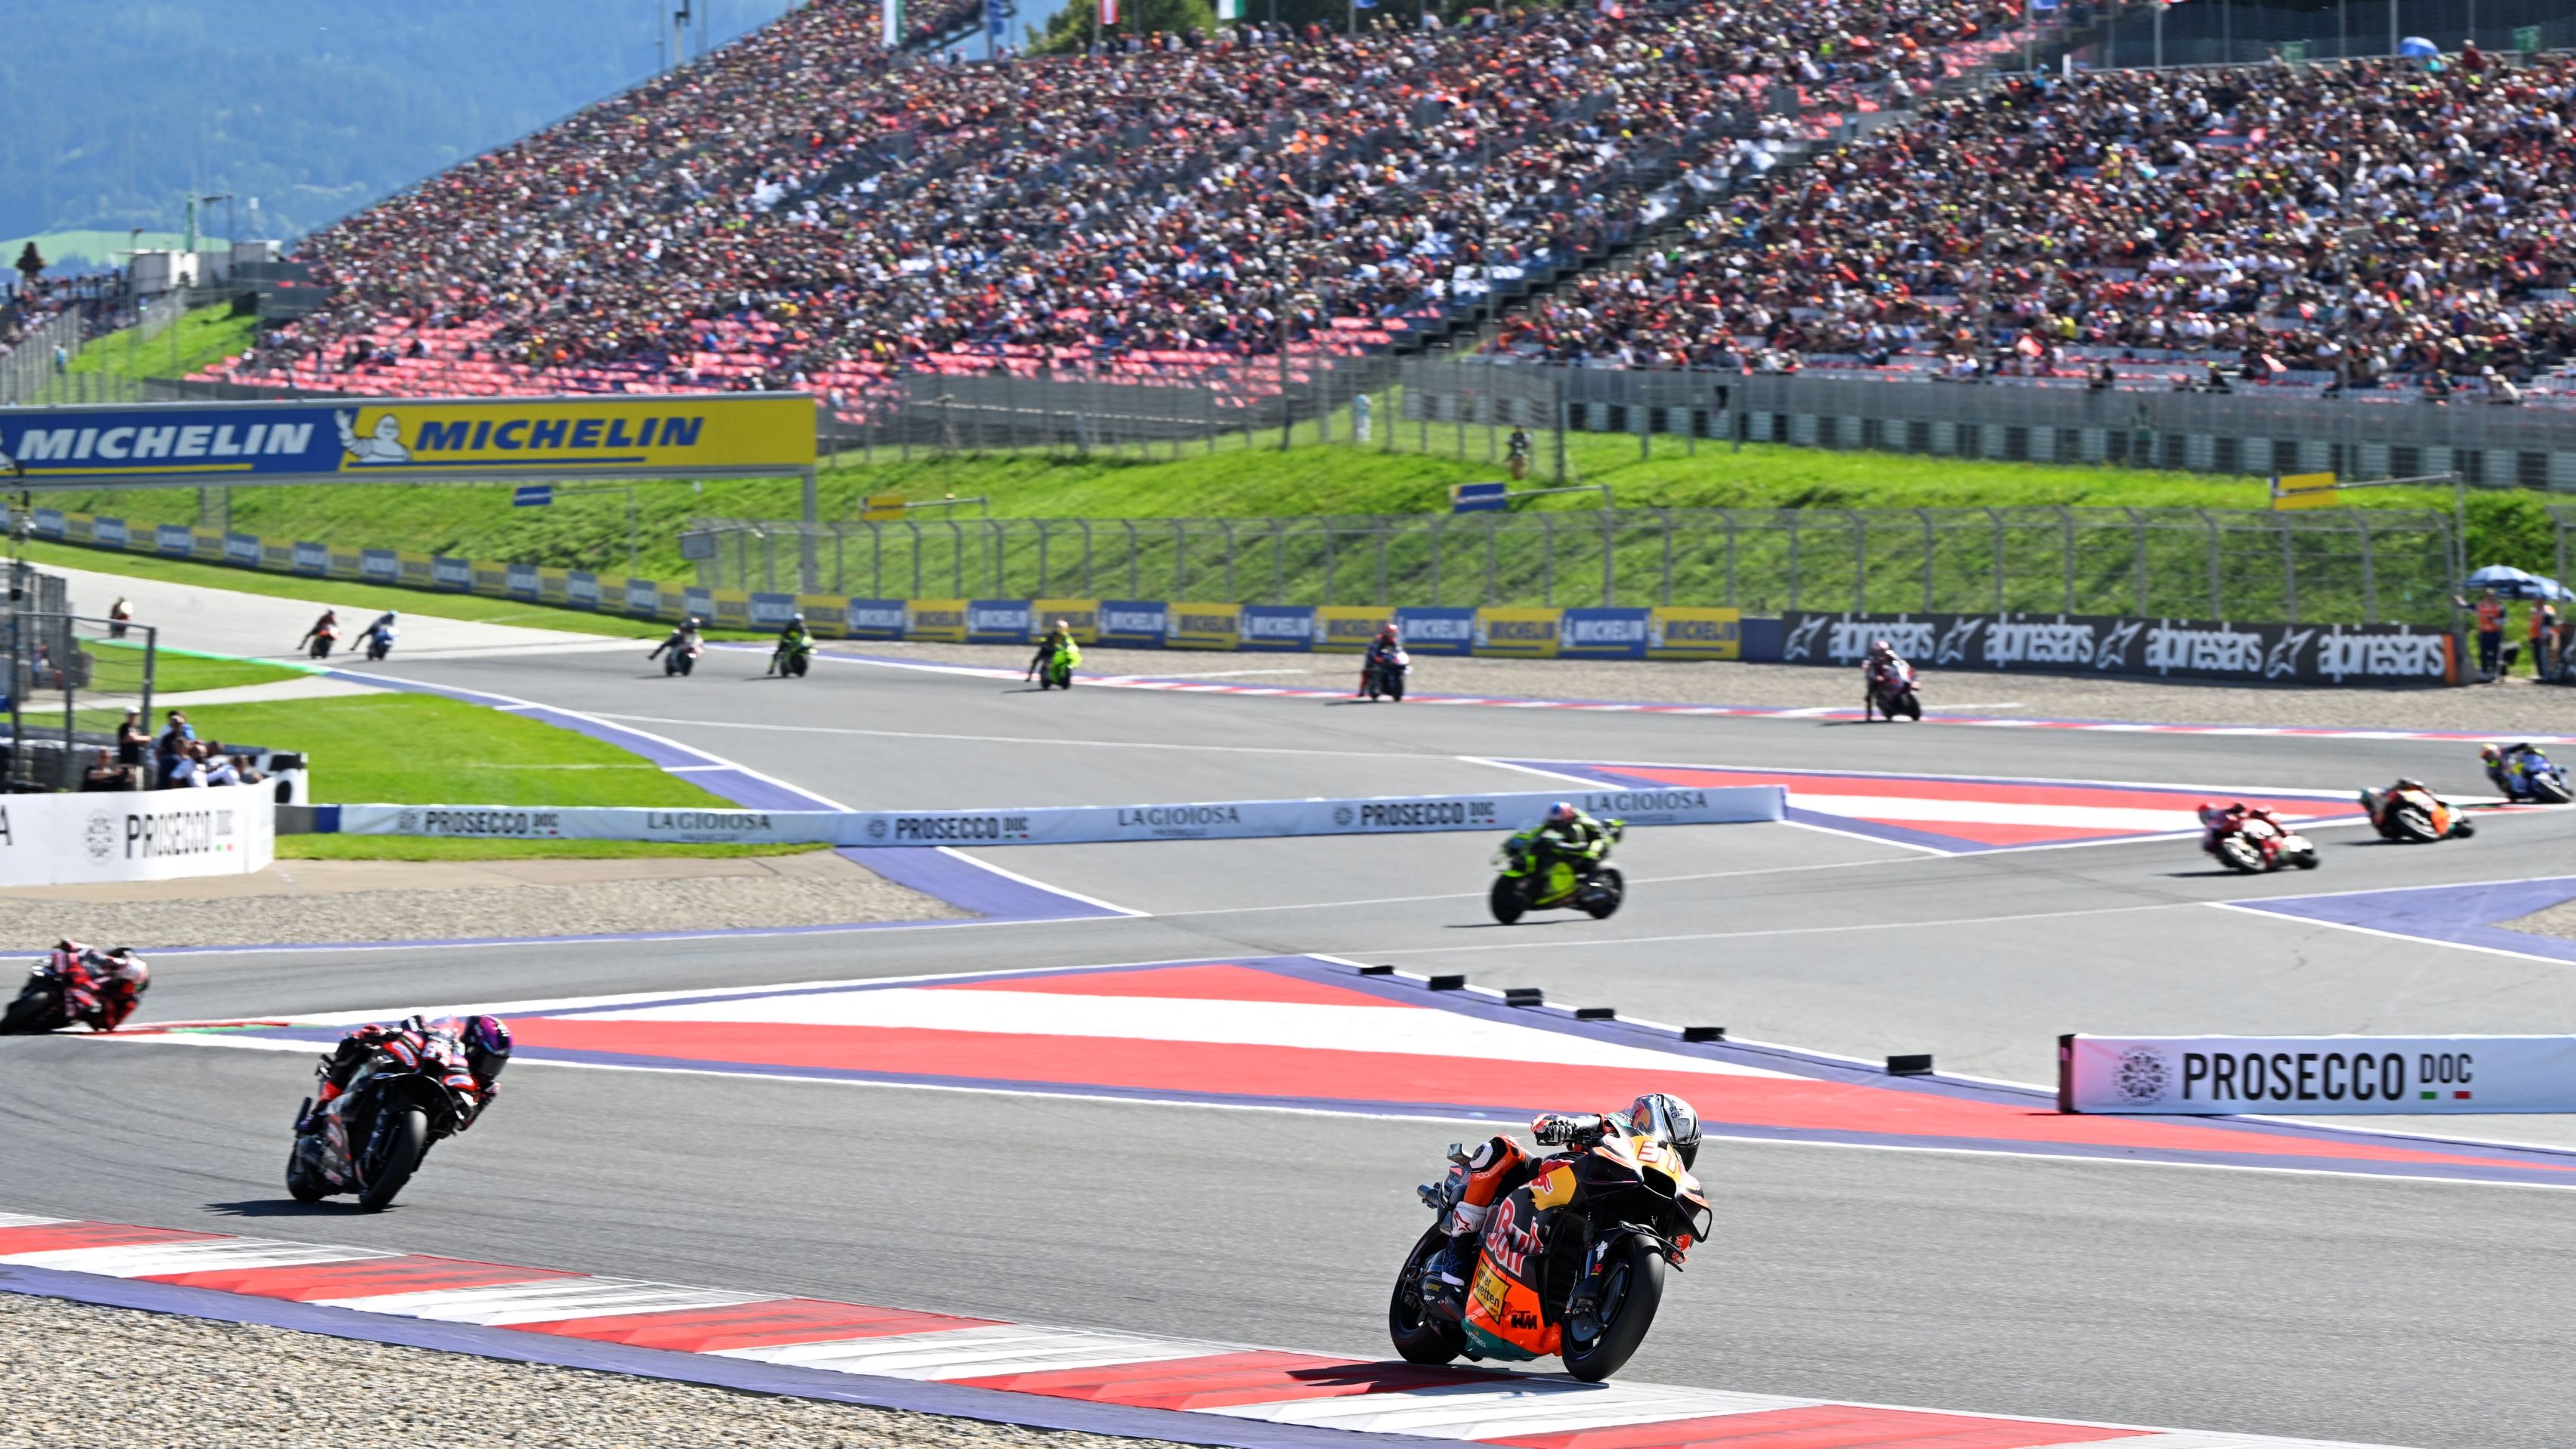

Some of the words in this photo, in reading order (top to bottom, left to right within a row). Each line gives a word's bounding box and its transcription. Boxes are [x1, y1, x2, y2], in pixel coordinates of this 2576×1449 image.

[17, 423, 314, 460] MICHELIN
[415, 416, 704, 451] MICHELIN
[425, 811, 527, 834] PROSECCO
[1361, 802, 1464, 826] PROSECCO
[895, 817, 999, 839] PROSECCO
[2182, 1052, 2405, 1101] PROSECCO
[2420, 1053, 2473, 1083] DOC
[1511, 1311, 1537, 1330] KTM
